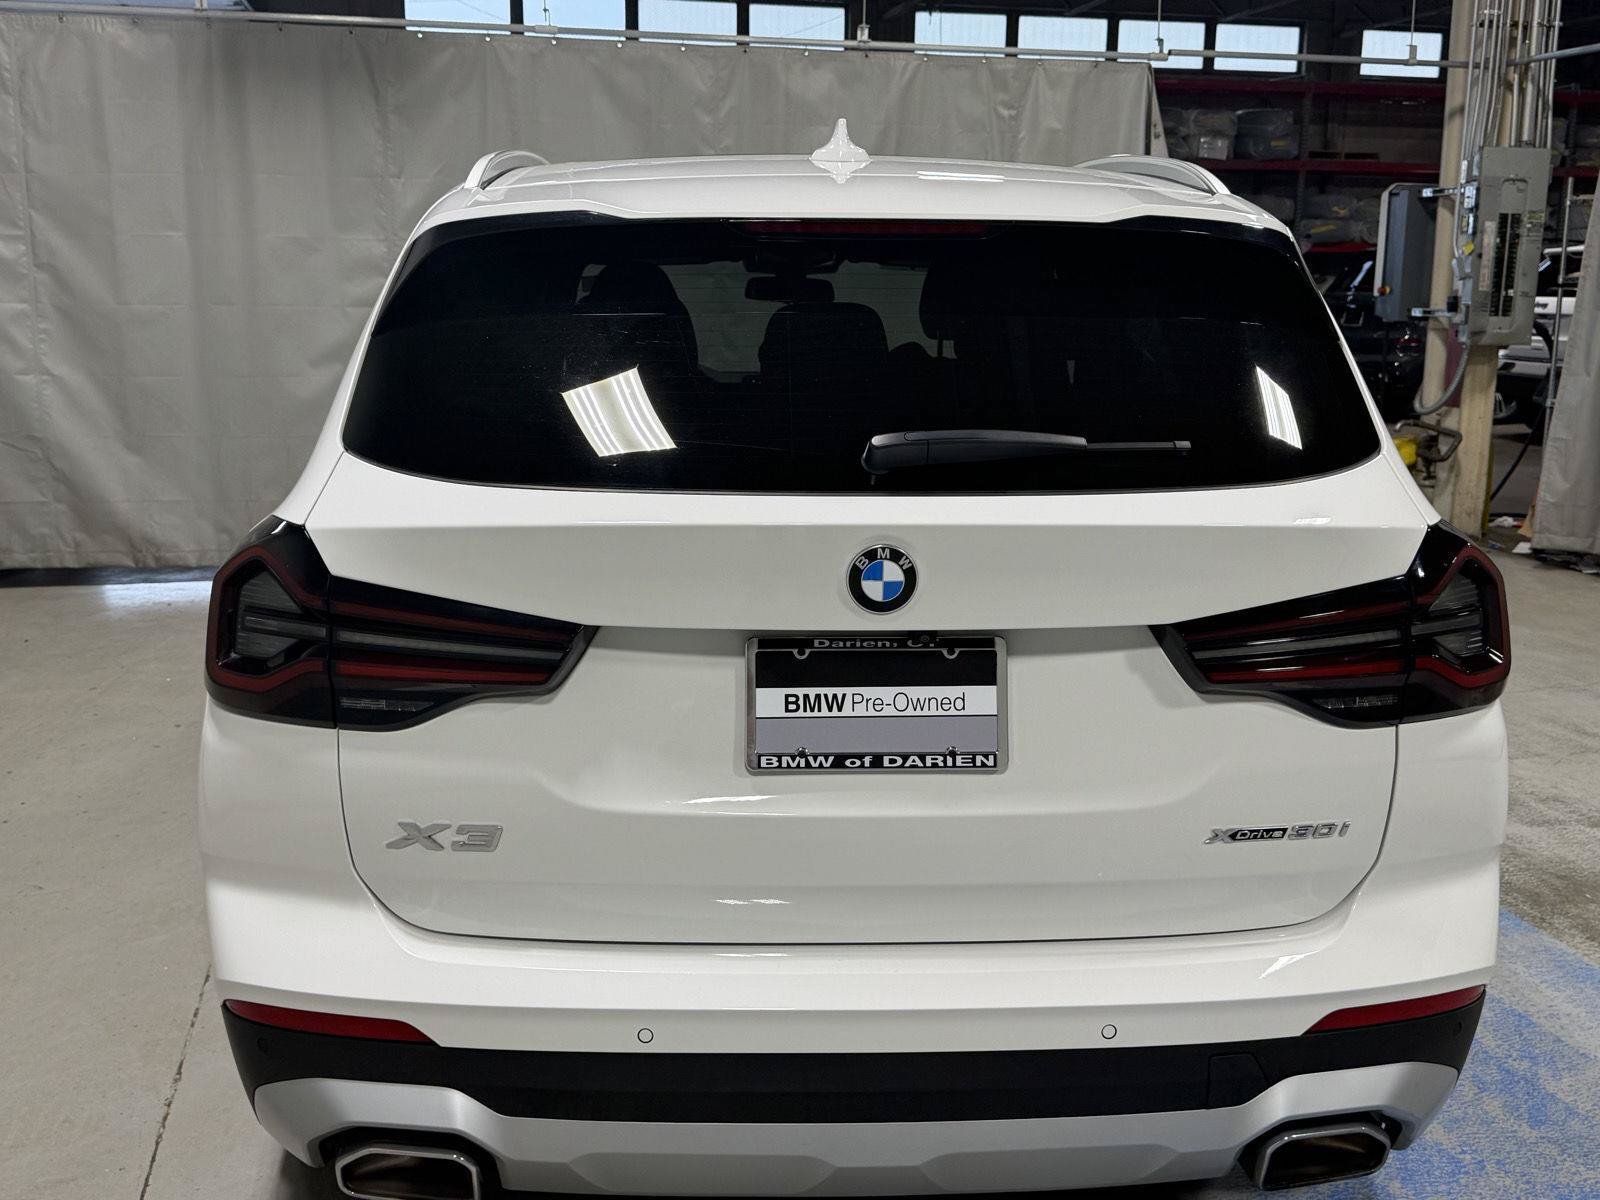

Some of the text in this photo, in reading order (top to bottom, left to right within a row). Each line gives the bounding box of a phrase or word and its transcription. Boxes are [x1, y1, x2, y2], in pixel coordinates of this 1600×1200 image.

[855, 547, 912, 570] BMW
[813, 639, 897, 648] Darien,
[784, 692, 966, 713] BMW Pre-Owned
[760, 754, 995, 768] BMW of DARIEN
[385, 821, 503, 852] X3
